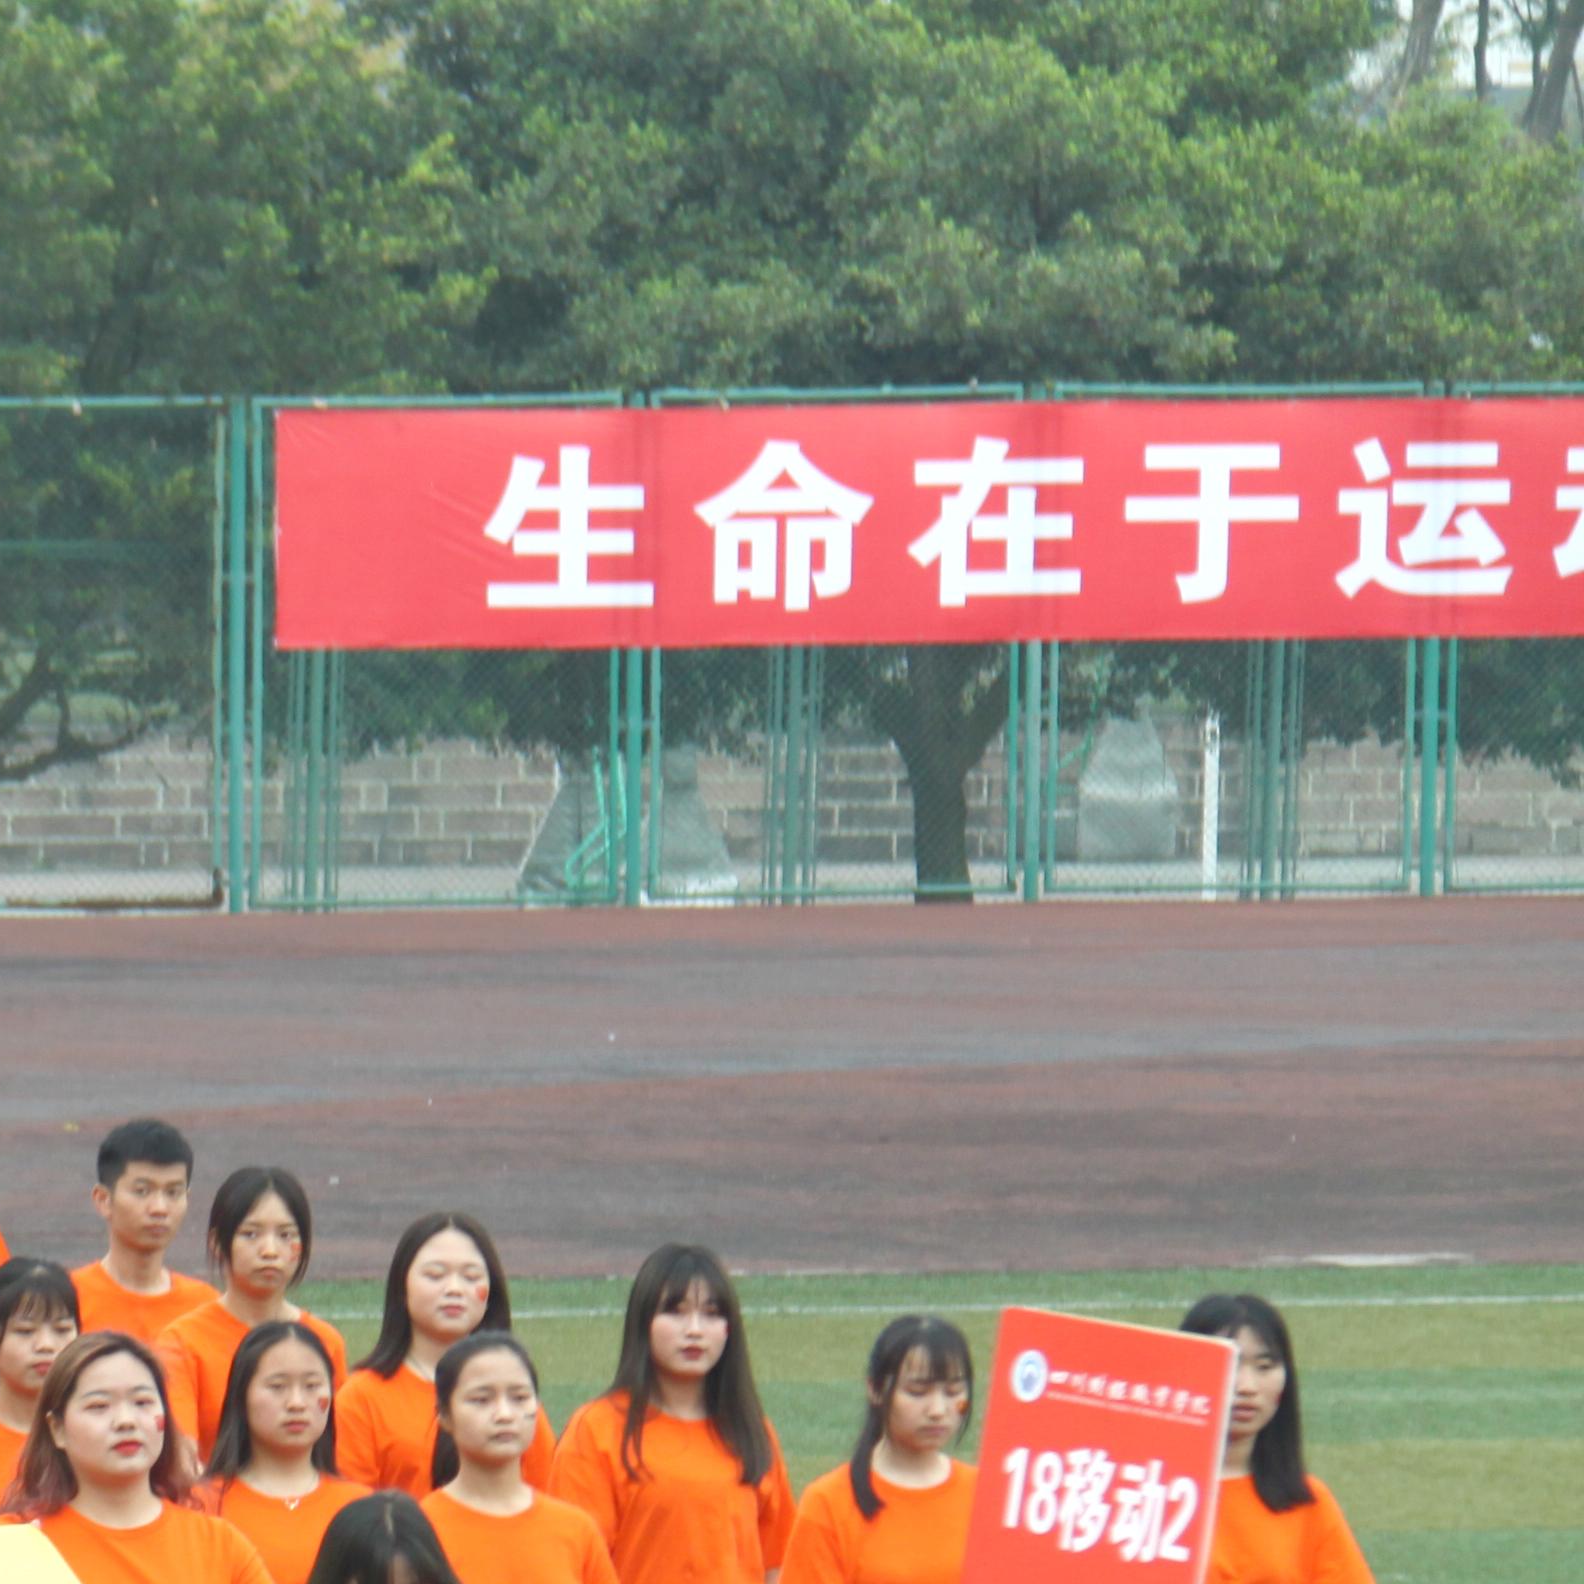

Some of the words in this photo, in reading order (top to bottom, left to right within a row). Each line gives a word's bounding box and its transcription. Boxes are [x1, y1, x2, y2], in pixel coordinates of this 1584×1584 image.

[484, 436, 1584, 611] 生命在于运
[1003, 1447, 1198, 1563] 18移动2
